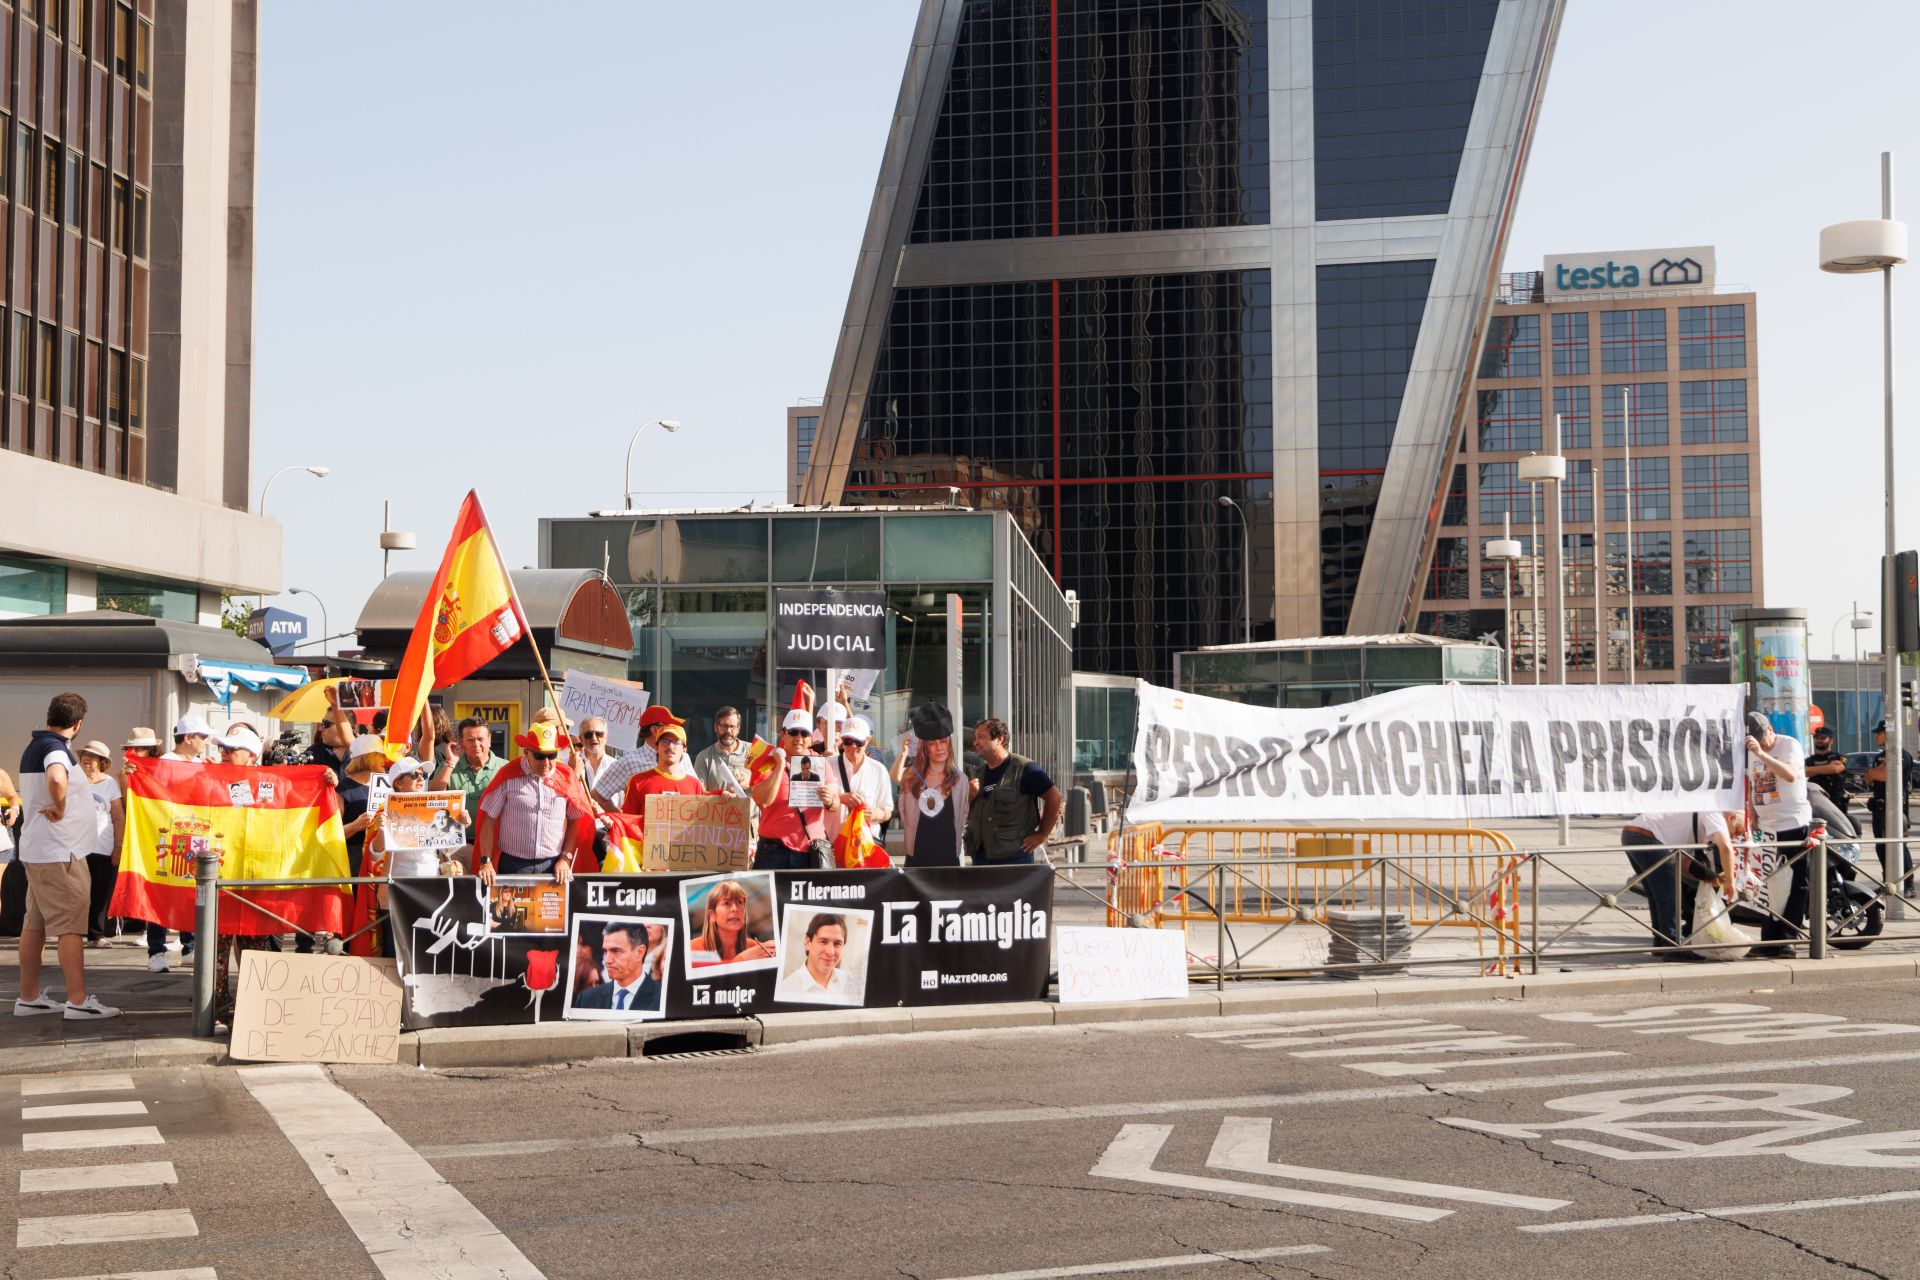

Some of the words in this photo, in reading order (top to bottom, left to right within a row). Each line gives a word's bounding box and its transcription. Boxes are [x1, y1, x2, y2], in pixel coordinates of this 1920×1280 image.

[1556, 261, 1640, 290] testa
[779, 602, 885, 617] INDEPENDENCIA
[248, 621, 264, 635] ATM
[270, 621, 302, 634] ATM
[787, 633, 875, 652] JUDICIAL
[472, 707, 509, 721] ATM
[564, 686, 643, 729] TRANSFORMA
[1145, 724, 1293, 802] PEDRO
[1299, 714, 1501, 797] SÁNCHEZ
[1510, 720, 1543, 794] A
[1547, 705, 1735, 793] PRISIÓN
[655, 798, 742, 825] BEGOÑA
[655, 822, 747, 851] FEMINISTA
[650, 843, 708, 864] MUJER
[717, 847, 744, 867] DE
[615, 888, 657, 910] capo
[807, 881, 866, 900] hermano
[880, 901, 920, 944] La
[928, 898, 1048, 950] Famiglia
[1062, 930, 1112, 957] Juez
[245, 958, 289, 992] NO
[300, 975, 321, 994] AL
[321, 961, 398, 997] GOLPE
[923, 979, 936, 987] HO
[692, 984, 711, 1006] La
[714, 985, 756, 1008] mujer
[264, 997, 302, 1026] DE
[320, 996, 402, 1029] ESTADO
[248, 1030, 283, 1057] DE
